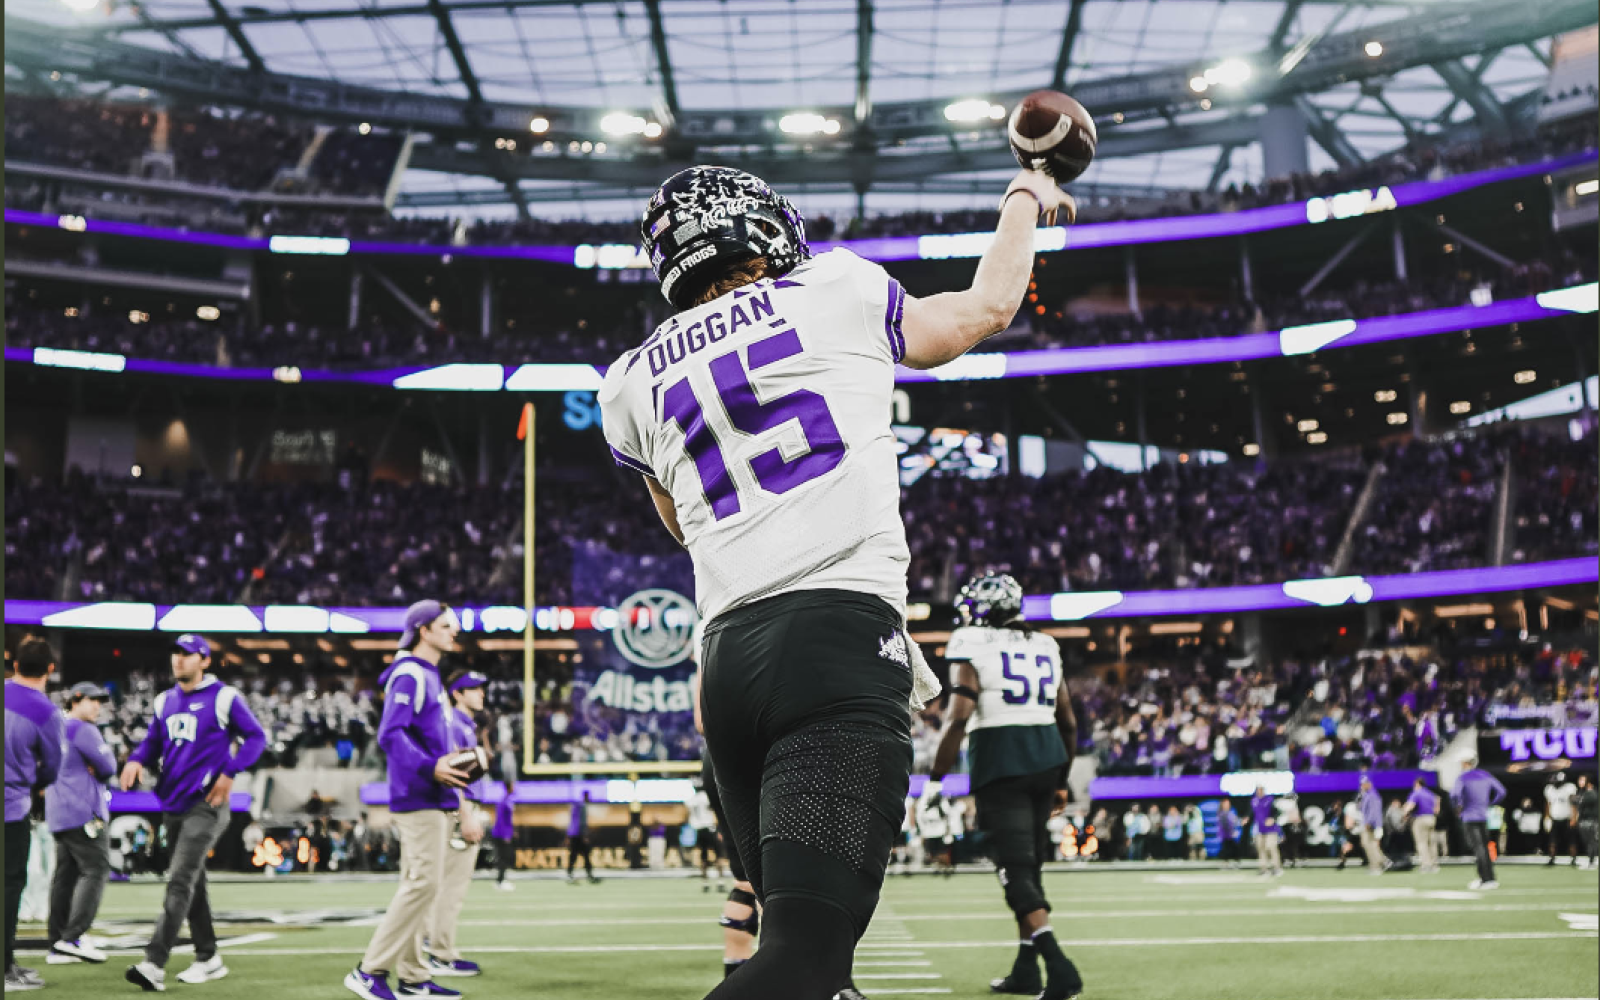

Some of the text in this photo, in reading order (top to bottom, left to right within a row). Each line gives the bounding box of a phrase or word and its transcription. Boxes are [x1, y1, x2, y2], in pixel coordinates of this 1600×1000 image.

[679, 244, 718, 271] FROGS
[648, 290, 775, 377] DUGGAN
[663, 328, 847, 522] 15
[1001, 651, 1055, 707] 52
[1500, 727, 1598, 761] TCU
[515, 847, 631, 869] NATINAL
